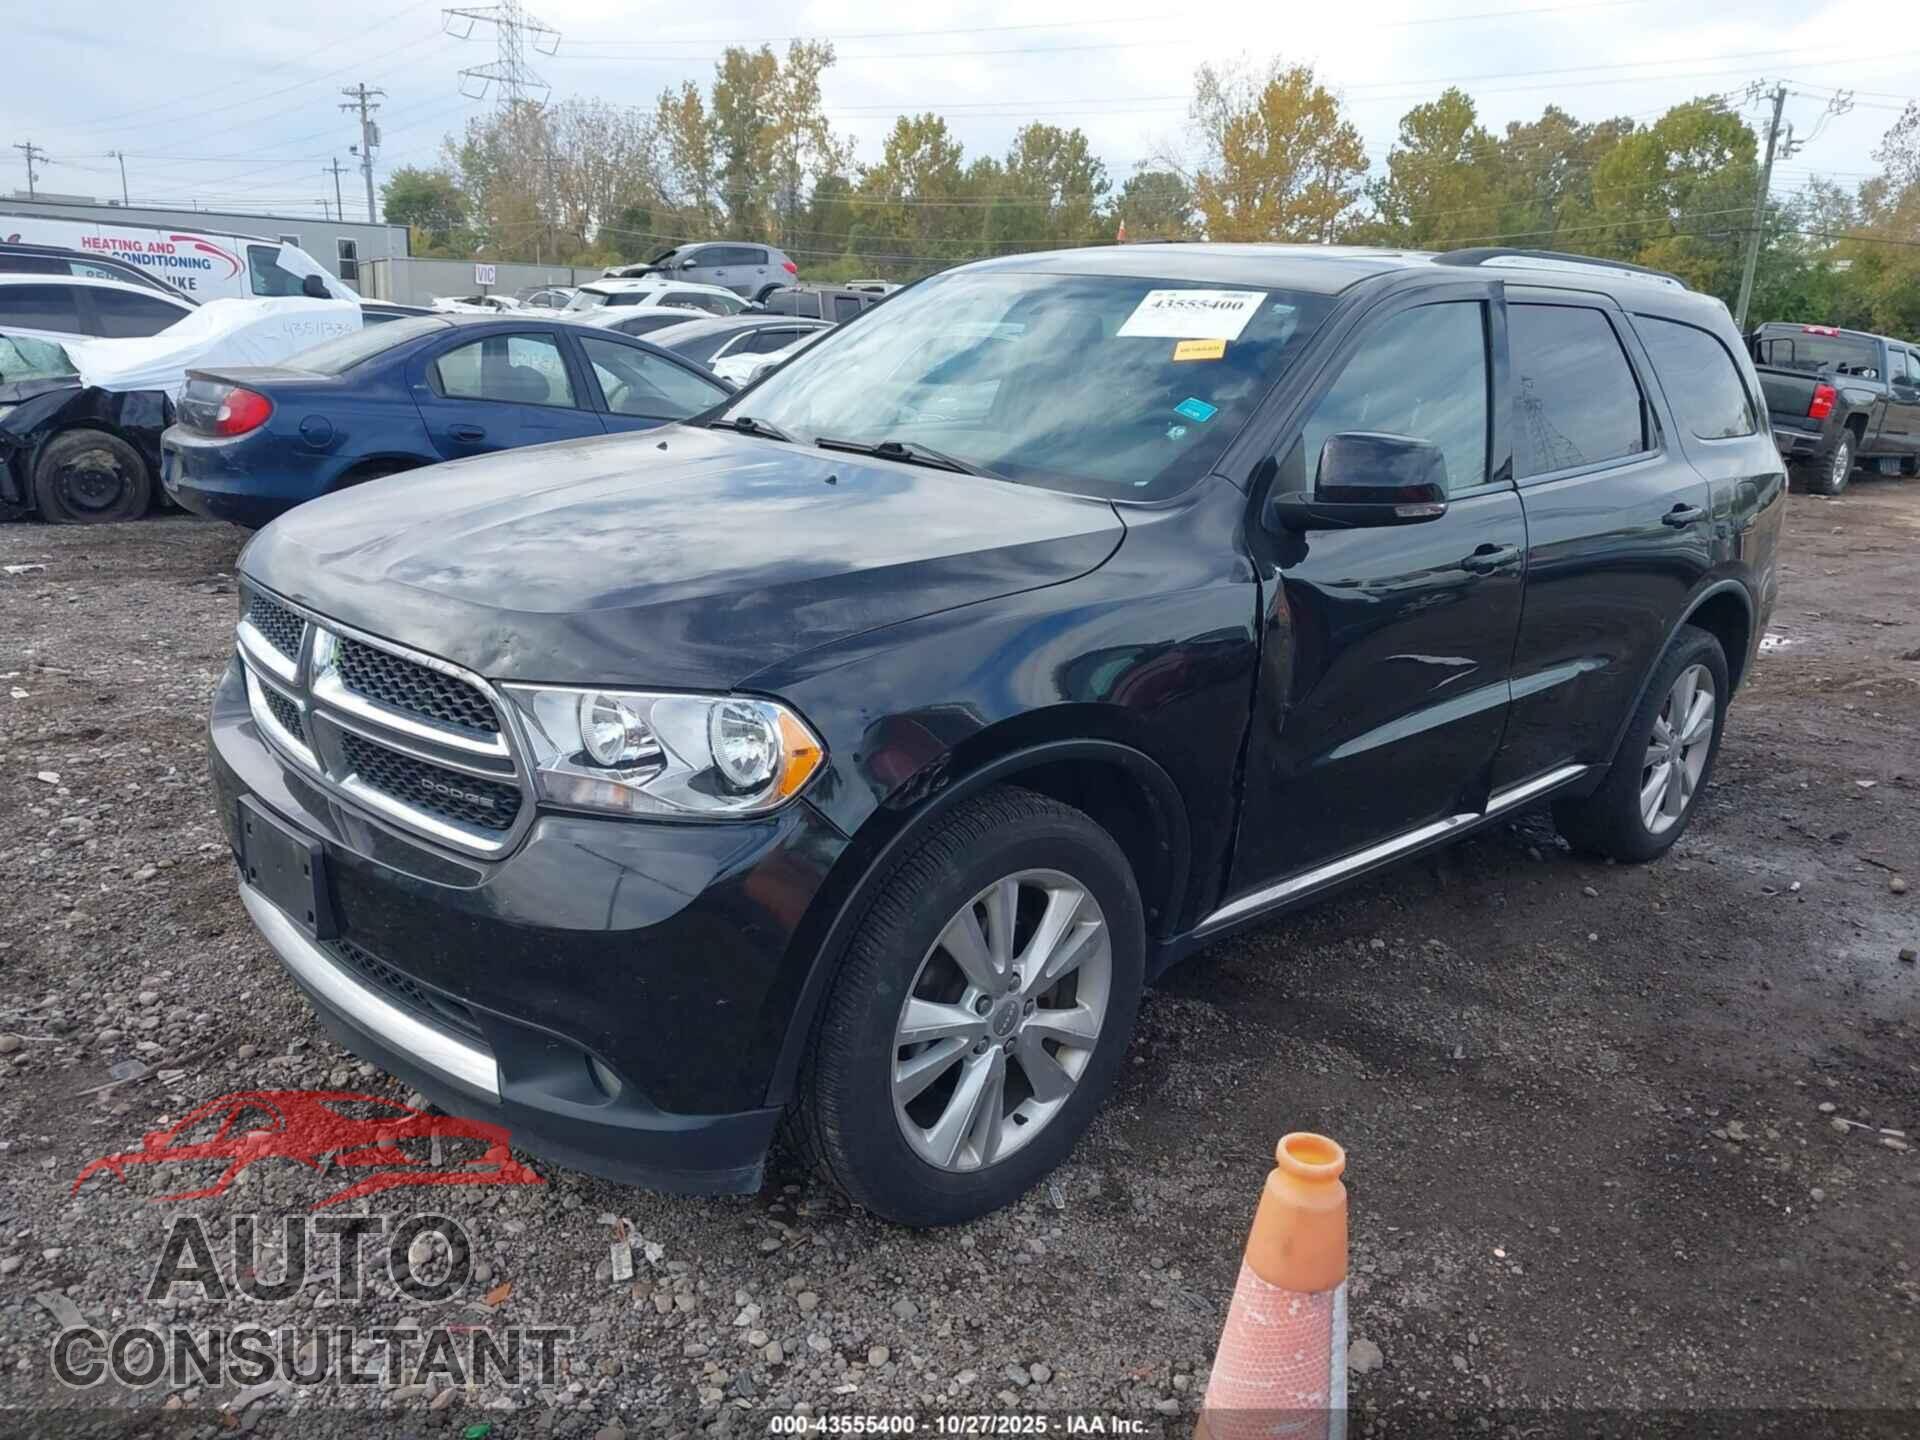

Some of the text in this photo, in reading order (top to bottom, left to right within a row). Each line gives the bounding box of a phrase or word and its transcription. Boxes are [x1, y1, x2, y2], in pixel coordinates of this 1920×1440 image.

[81, 236, 176, 254] HEATING AND
[1152, 299, 1244, 310] 43555400
[421, 778, 495, 808] DODGE
